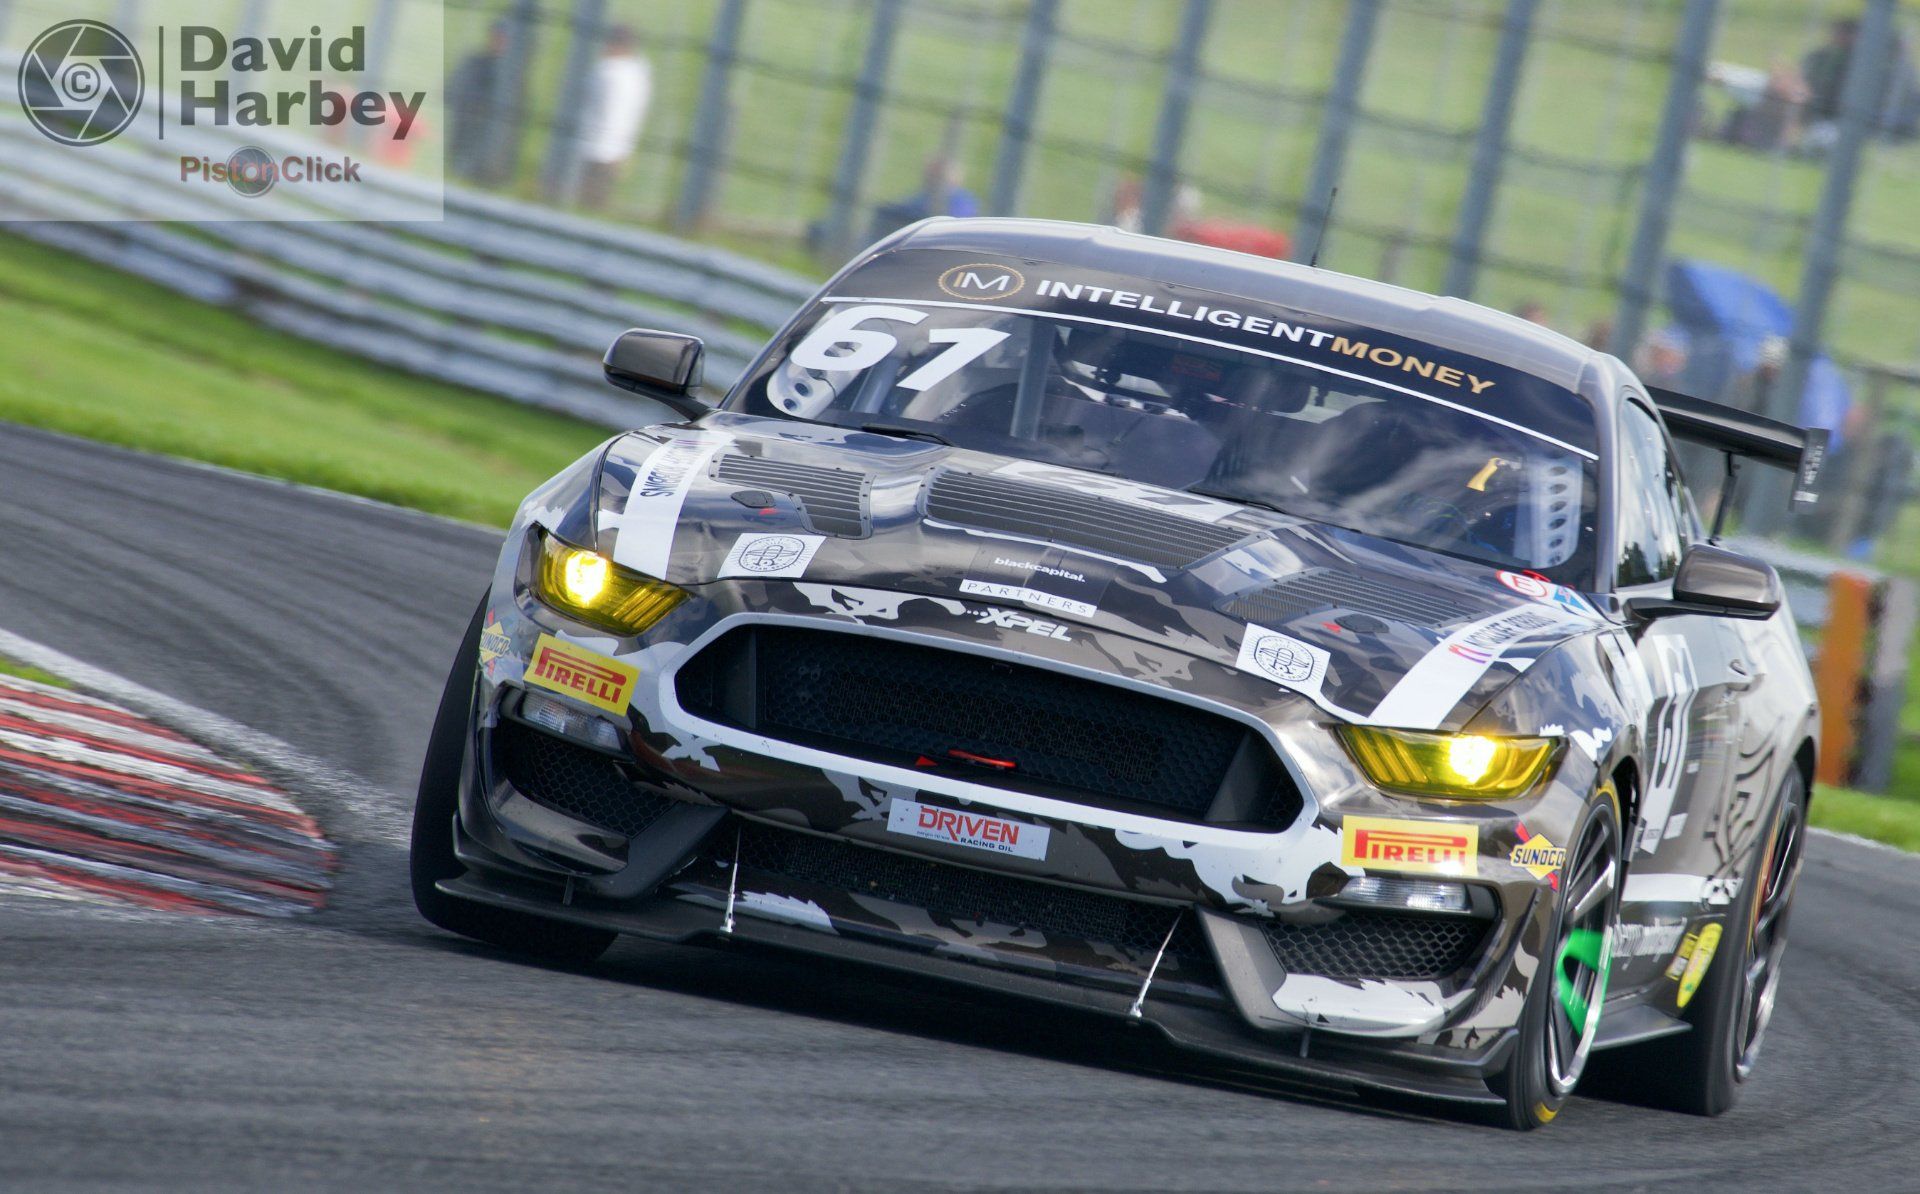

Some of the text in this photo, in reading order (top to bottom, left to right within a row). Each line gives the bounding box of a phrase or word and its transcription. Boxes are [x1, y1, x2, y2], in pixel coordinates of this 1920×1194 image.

[790, 304, 1012, 392] 61
[966, 582, 1088, 615] PARTNERS
[975, 607, 1073, 642] XPEL
[535, 646, 627, 705] PIRELLI
[918, 806, 1020, 845] DRIVEN
[960, 837, 1014, 853] RACING OIL
[1354, 828, 1469, 866] PIRELLI
[1513, 847, 1565, 867] SUNOCO
